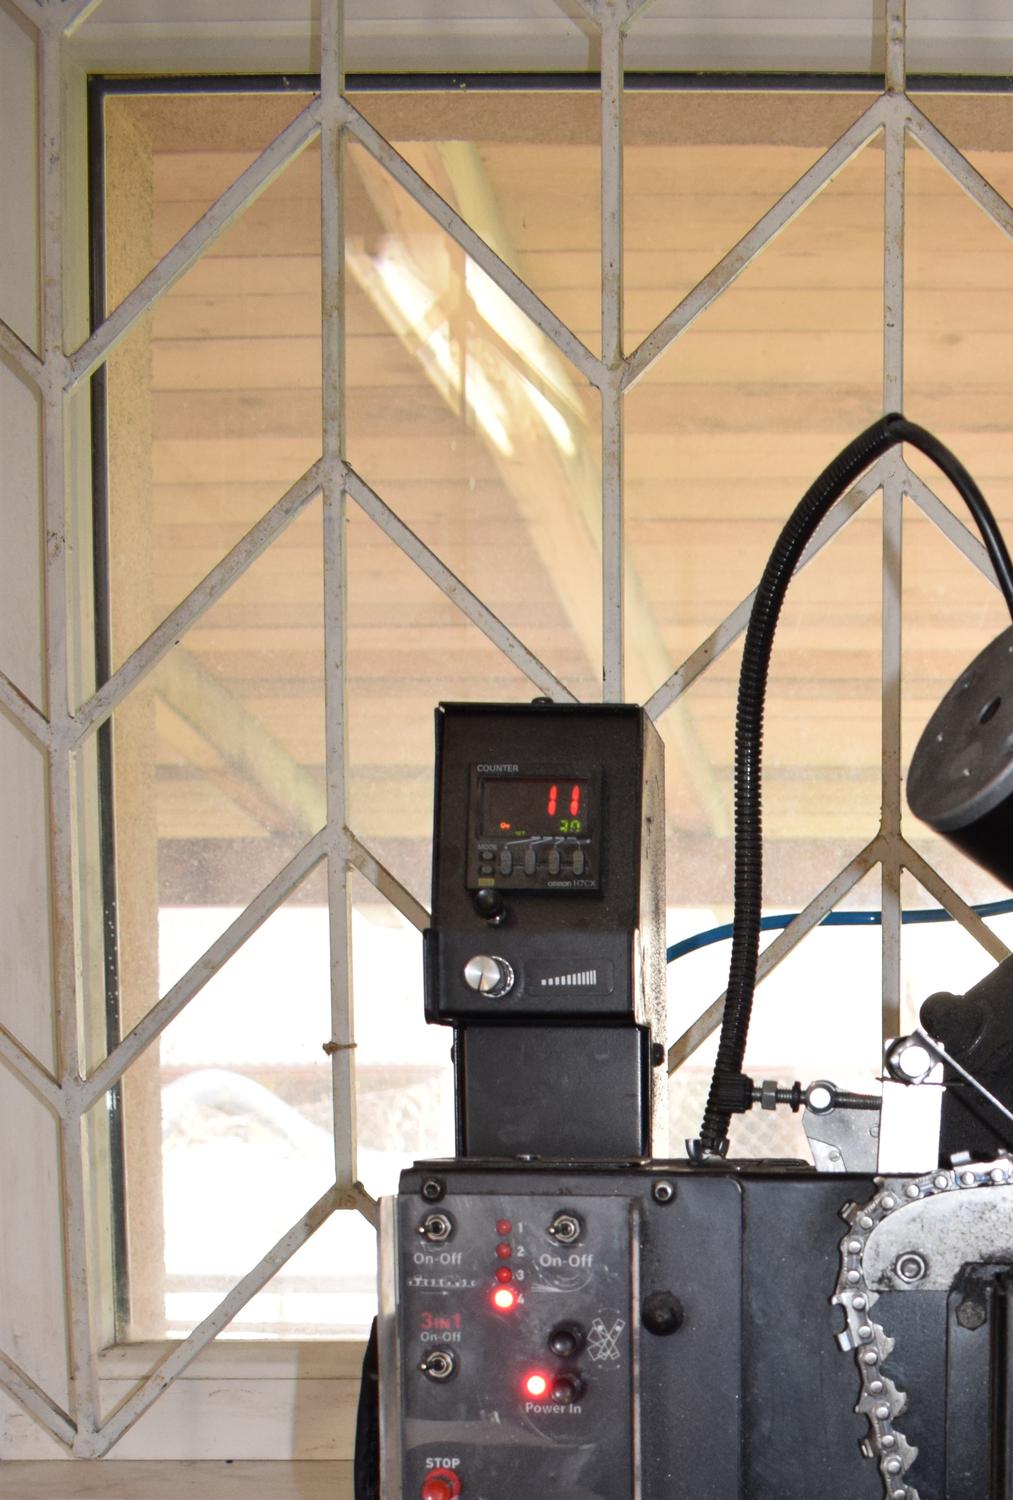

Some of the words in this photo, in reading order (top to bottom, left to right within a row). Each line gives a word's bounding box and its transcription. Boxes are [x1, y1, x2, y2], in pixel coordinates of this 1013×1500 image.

[477, 764, 519, 773] COUNTER
[547, 783, 581, 817] 11
[517, 1221, 524, 1233] 1
[516, 1245, 526, 1257] 2
[413, 1252, 463, 1265] On-Off
[539, 1253, 594, 1268] On-Off
[516, 1270, 525, 1281] 3
[517, 1294, 525, 1305] 4
[420, 1331, 462, 1343] On-Off
[525, 1402, 565, 1415] Power
[569, 1402, 582, 1414] In
[425, 1457, 461, 1469] STOP
